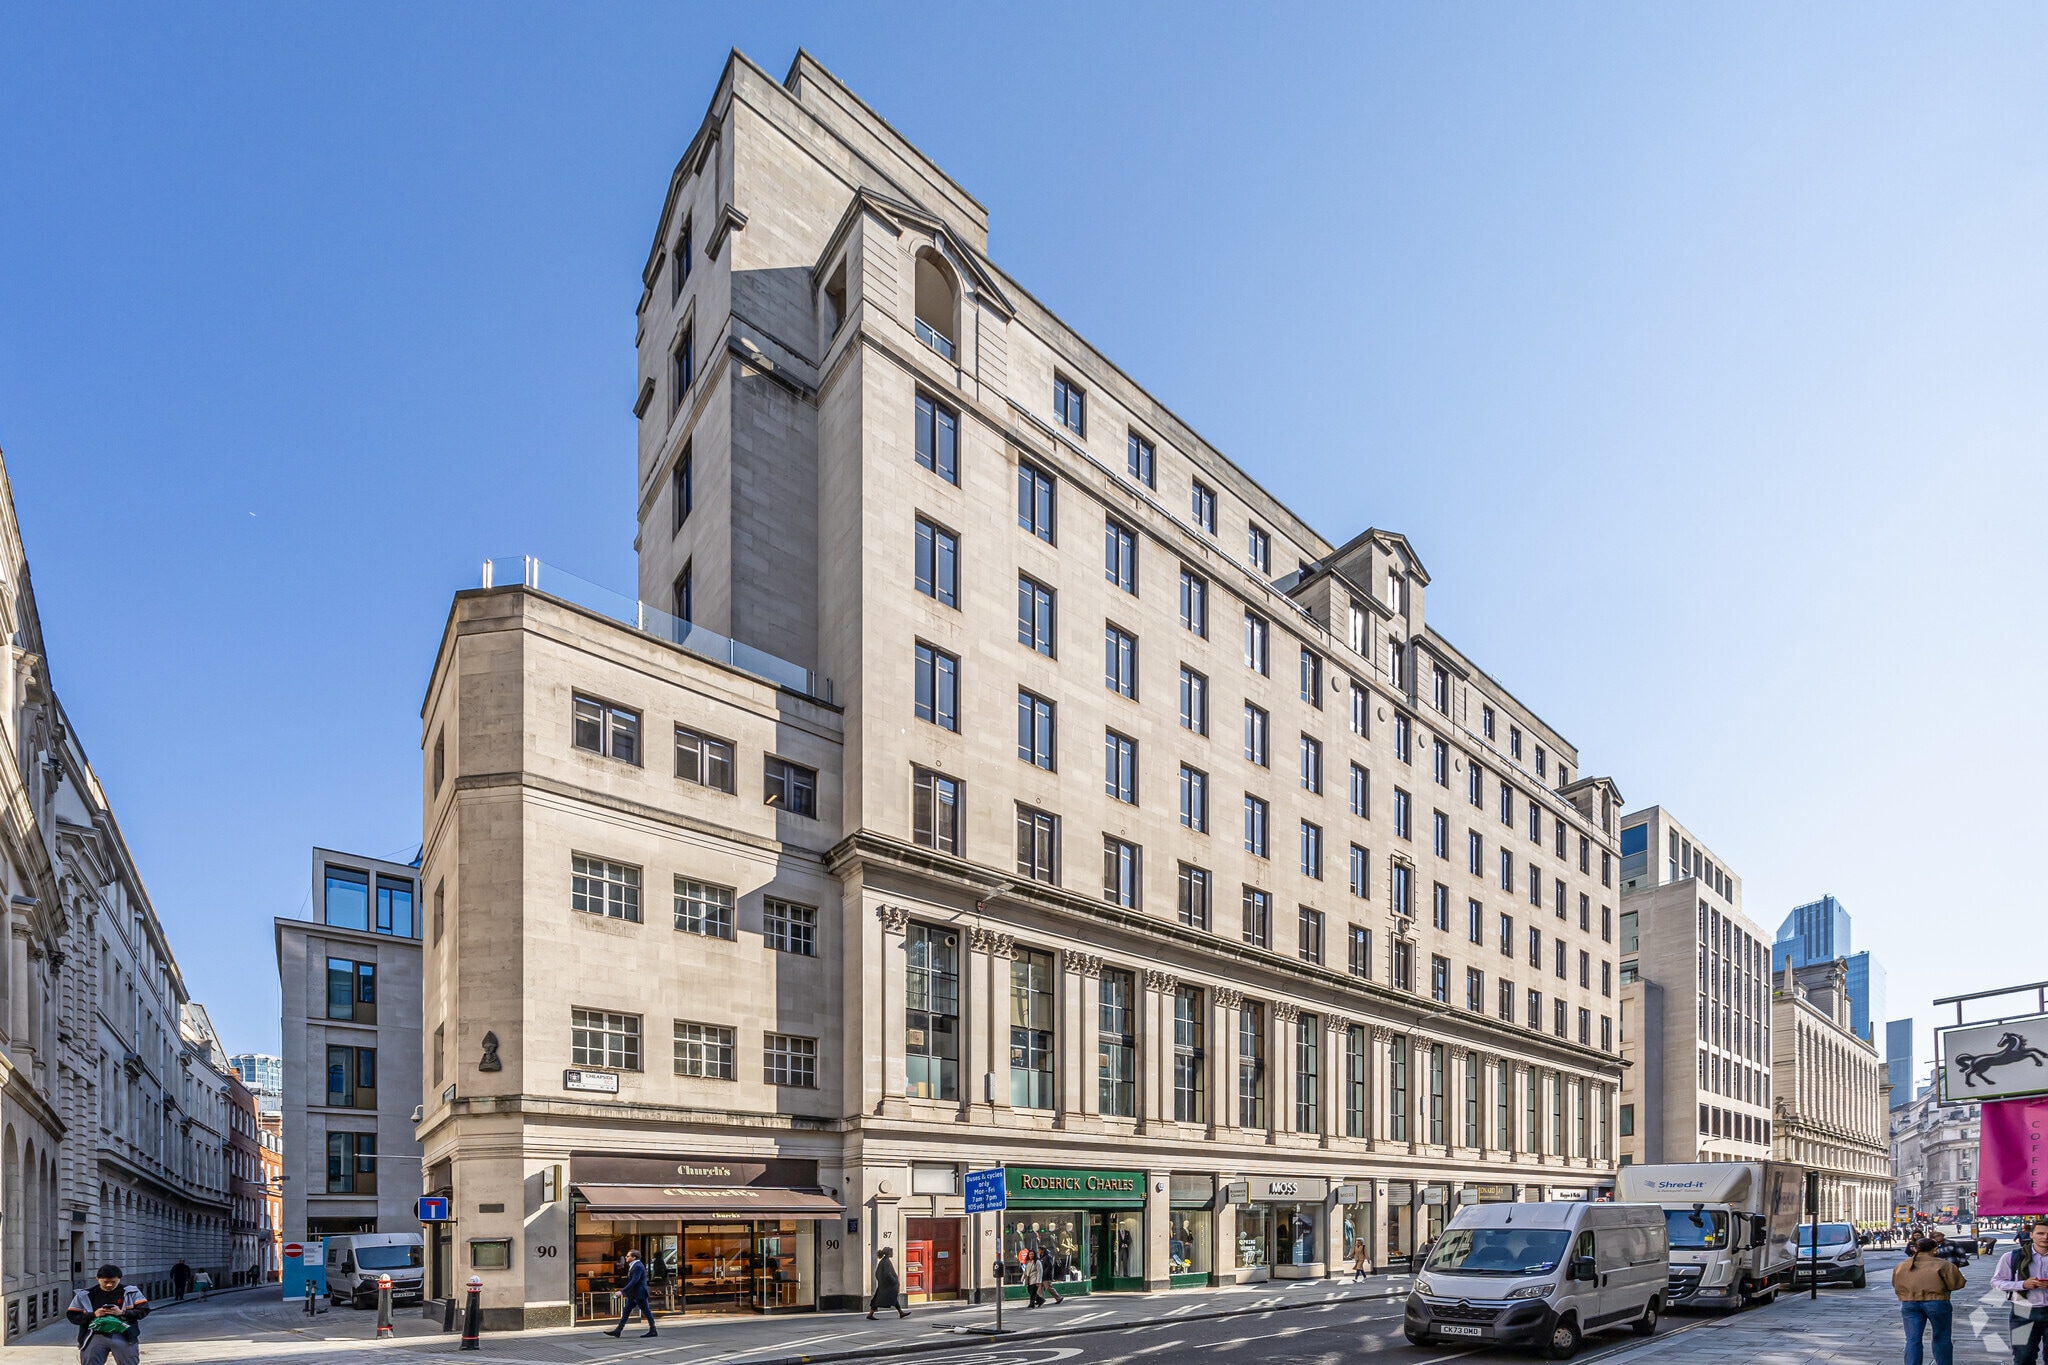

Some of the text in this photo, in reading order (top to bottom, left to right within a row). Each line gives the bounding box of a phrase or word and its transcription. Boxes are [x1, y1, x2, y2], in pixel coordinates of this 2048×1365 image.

[2030, 1121, 2041, 1188] COFFEE
[677, 1164, 731, 1176] Church's
[1021, 1174, 1134, 1191] RODERICK CHARLES
[1271, 1182, 1298, 1194] MOSS
[663, 1188, 760, 1197] Church's
[882, 1231, 893, 1239] 87
[984, 1229, 993, 1237] 87
[825, 1239, 840, 1250] 90
[537, 1245, 557, 1258] 90
[1443, 1326, 1463, 1334] CK73
